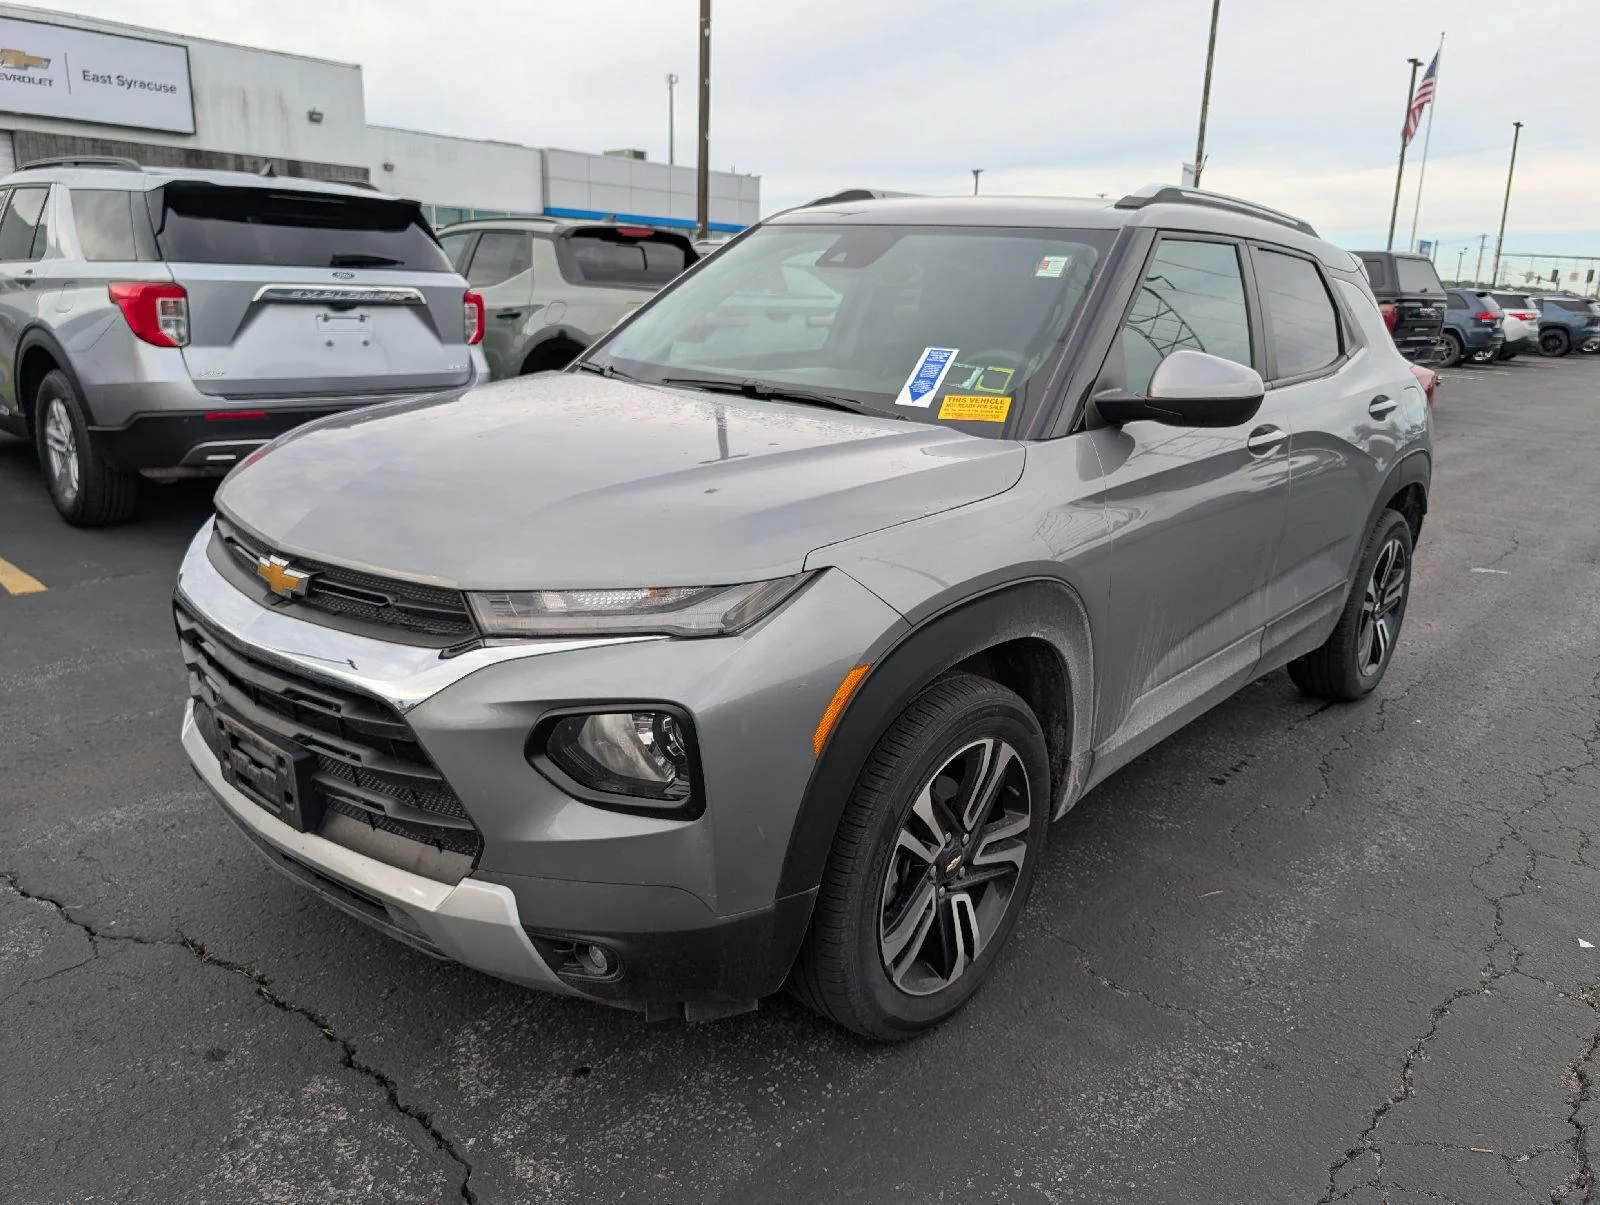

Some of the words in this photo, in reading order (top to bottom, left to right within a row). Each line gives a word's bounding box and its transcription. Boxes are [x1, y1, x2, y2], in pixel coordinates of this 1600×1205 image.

[82, 69, 113, 84] East
[116, 74, 177, 94] Syracuse
[969, 397, 1005, 405] VEHICLE
